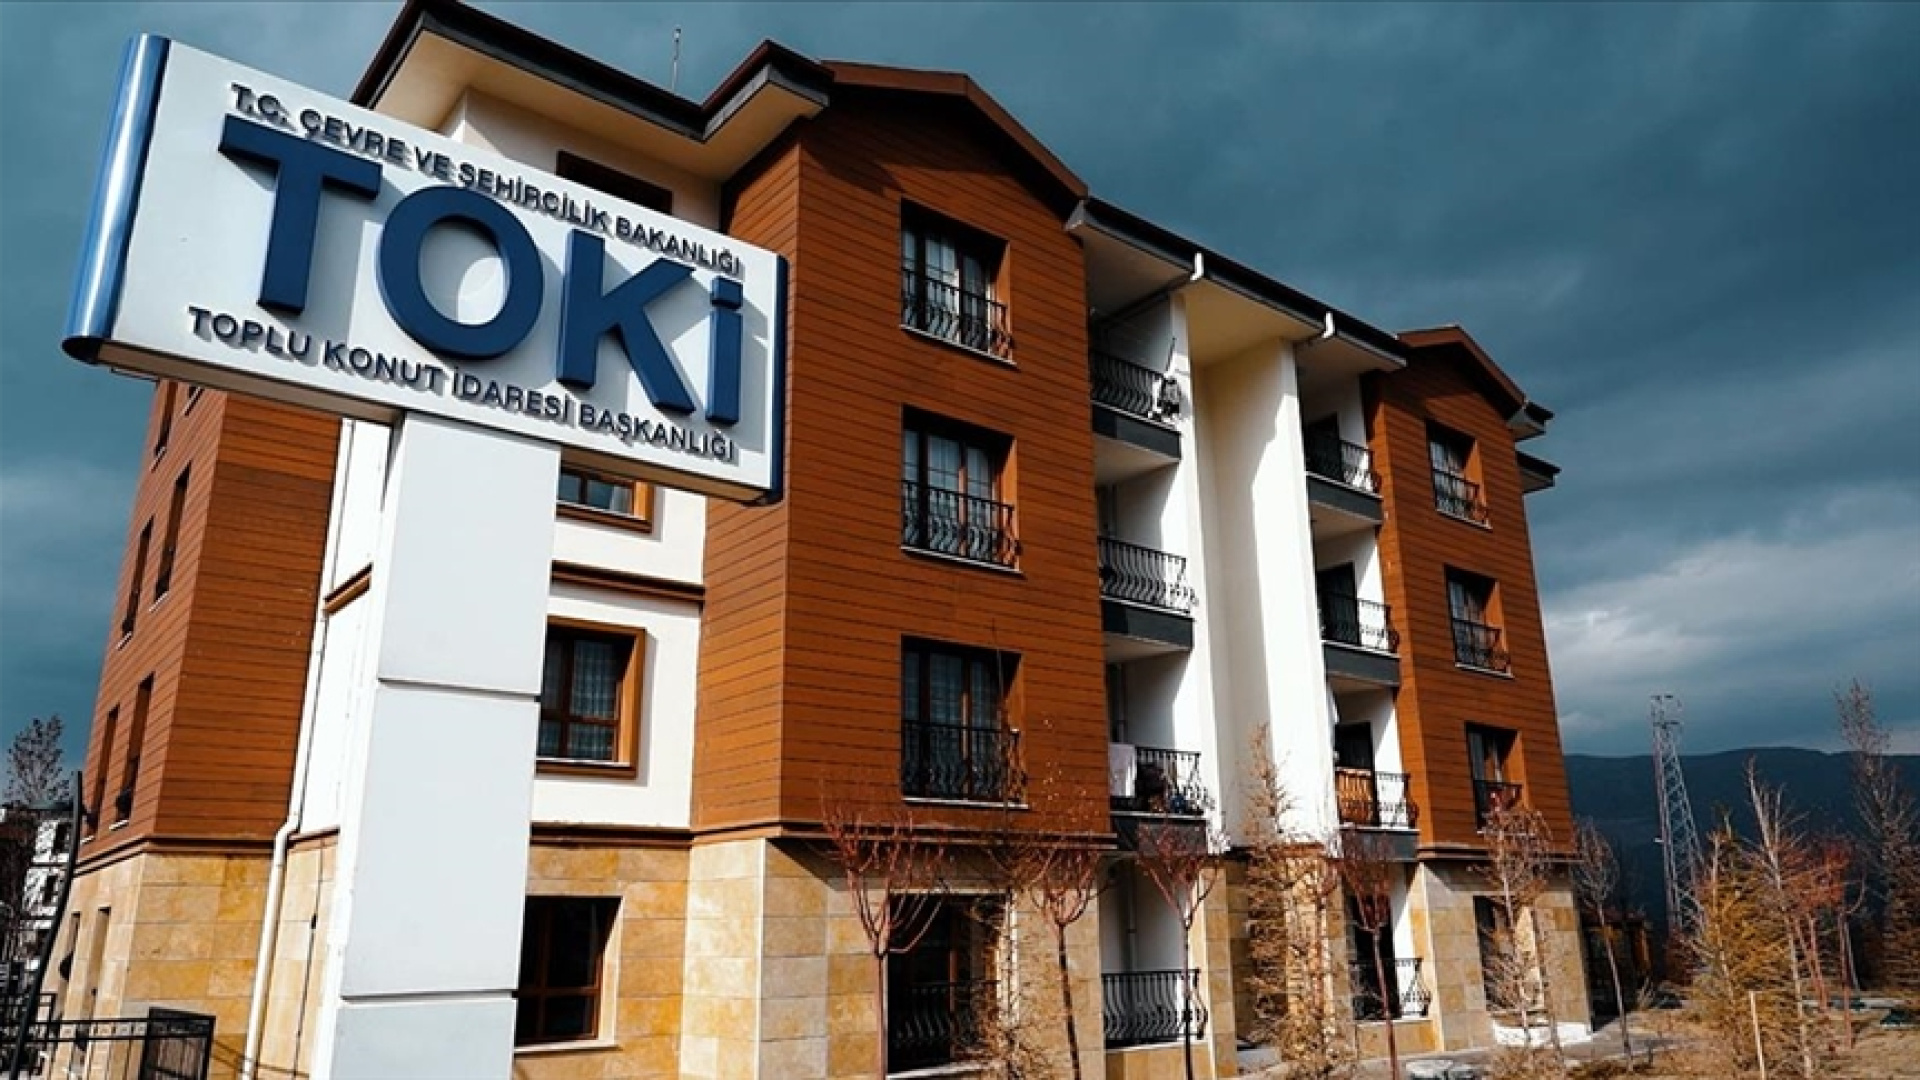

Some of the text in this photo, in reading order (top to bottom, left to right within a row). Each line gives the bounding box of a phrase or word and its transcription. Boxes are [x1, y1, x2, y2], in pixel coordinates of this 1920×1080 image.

[231, 82, 288, 124] T.C.
[300, 108, 407, 162] ÇEVRE
[414, 145, 452, 179] VE
[615, 215, 741, 274] BAKANLIĞI
[188, 305, 735, 462] TOPLU KONUT İDARESİ BAŞKANLIĞI
